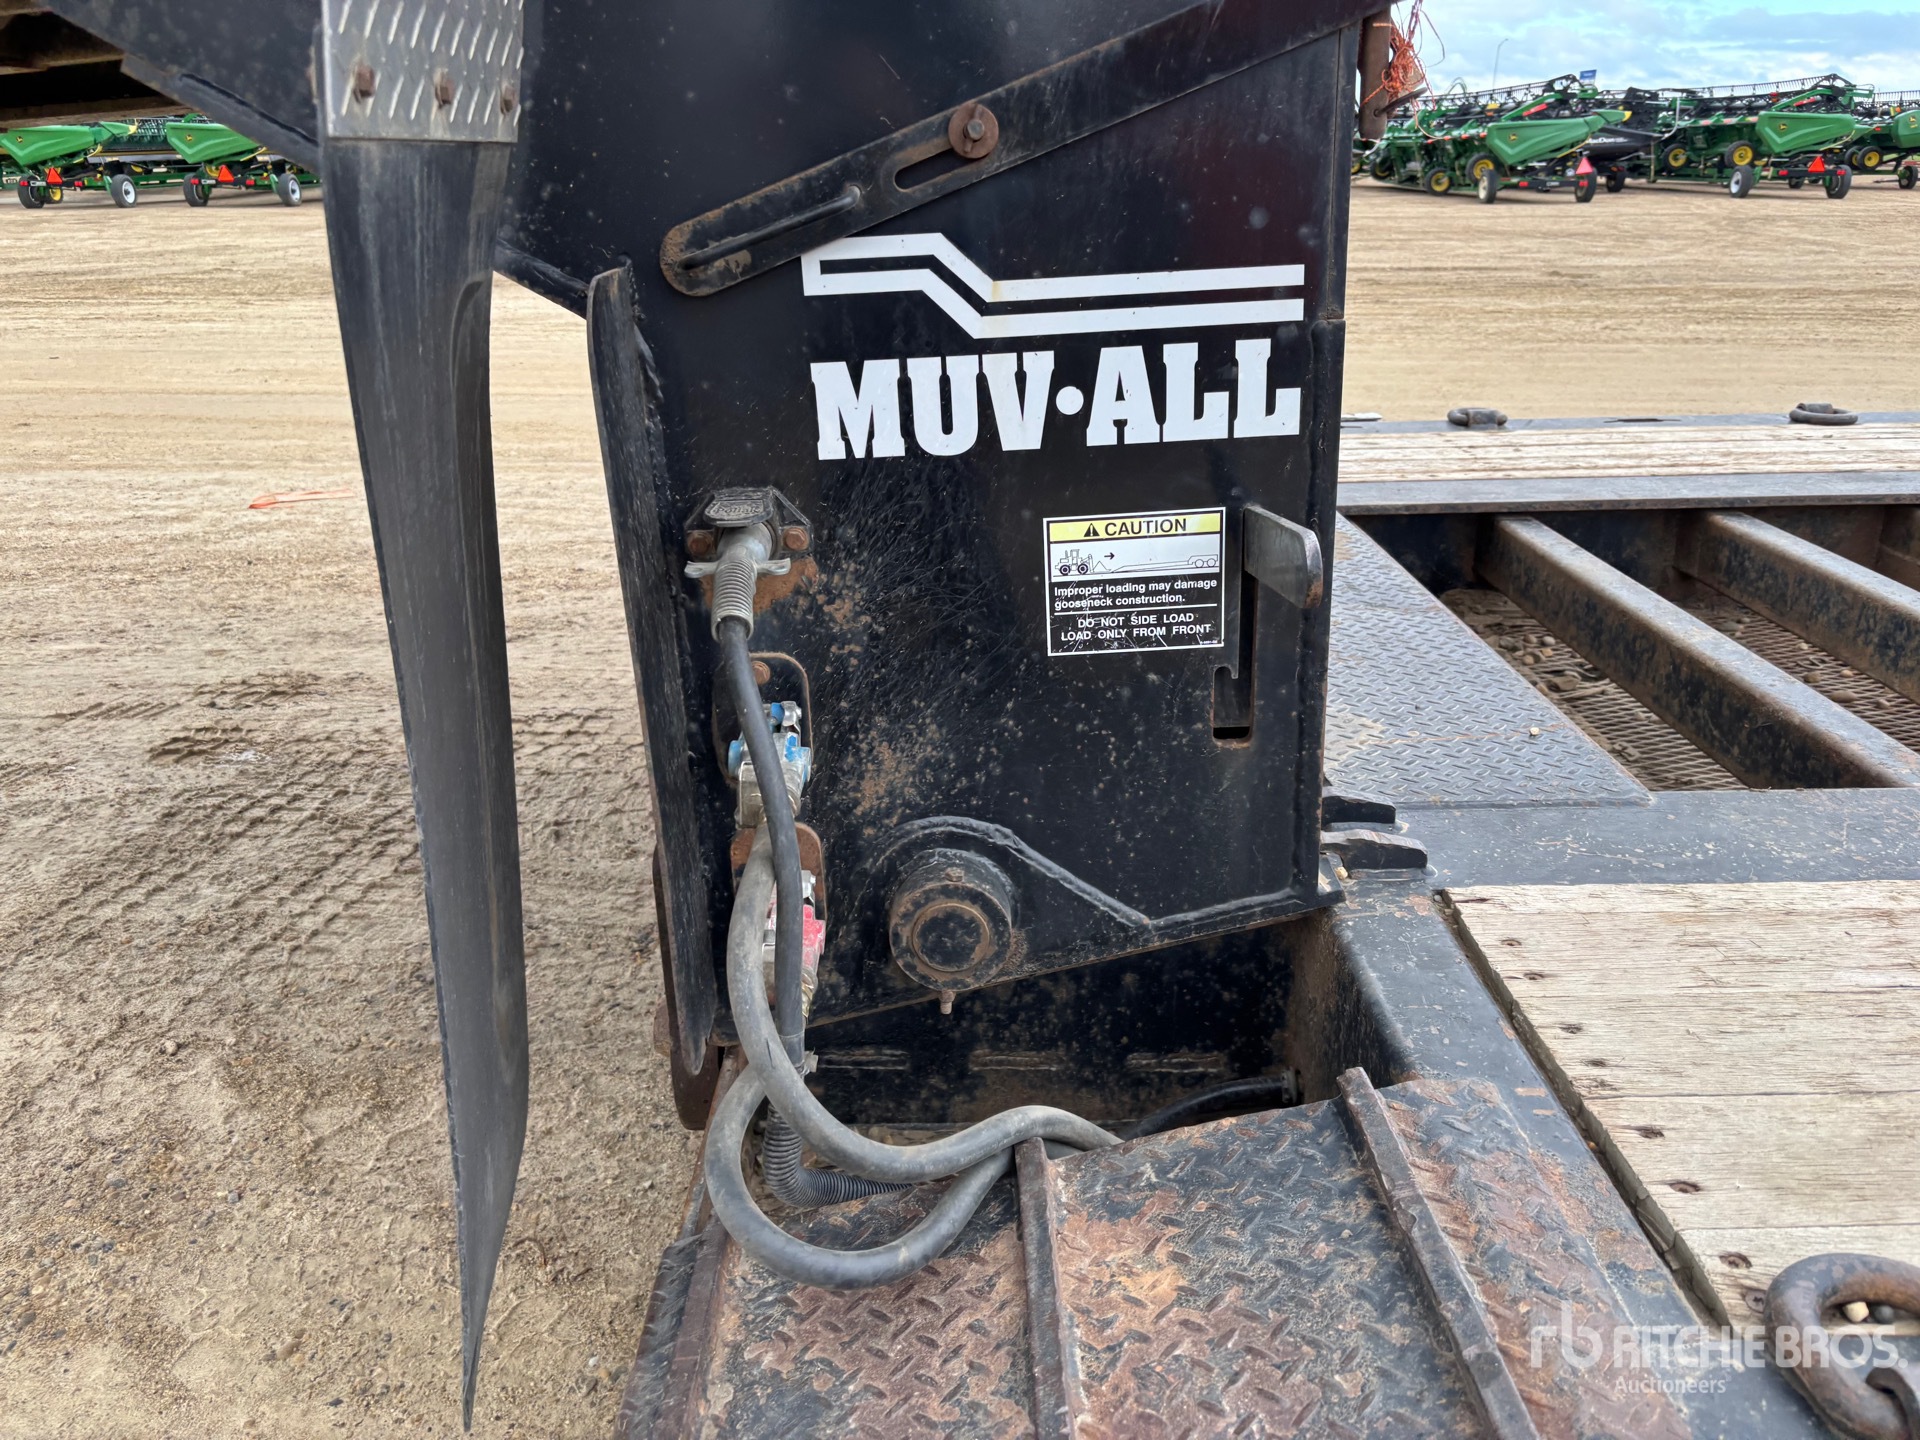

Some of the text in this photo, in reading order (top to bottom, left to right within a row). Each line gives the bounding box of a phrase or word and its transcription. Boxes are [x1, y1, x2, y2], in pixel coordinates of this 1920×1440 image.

[1104, 518, 1187, 537] CAUTION
[1054, 579, 1217, 598] Improper loading may damage
[1054, 594, 1186, 611] gooseneck construction.
[1077, 613, 1195, 628] DO NOT SIDE LOAD
[1061, 624, 1212, 641] LOAD ONLY FROM FRONT
